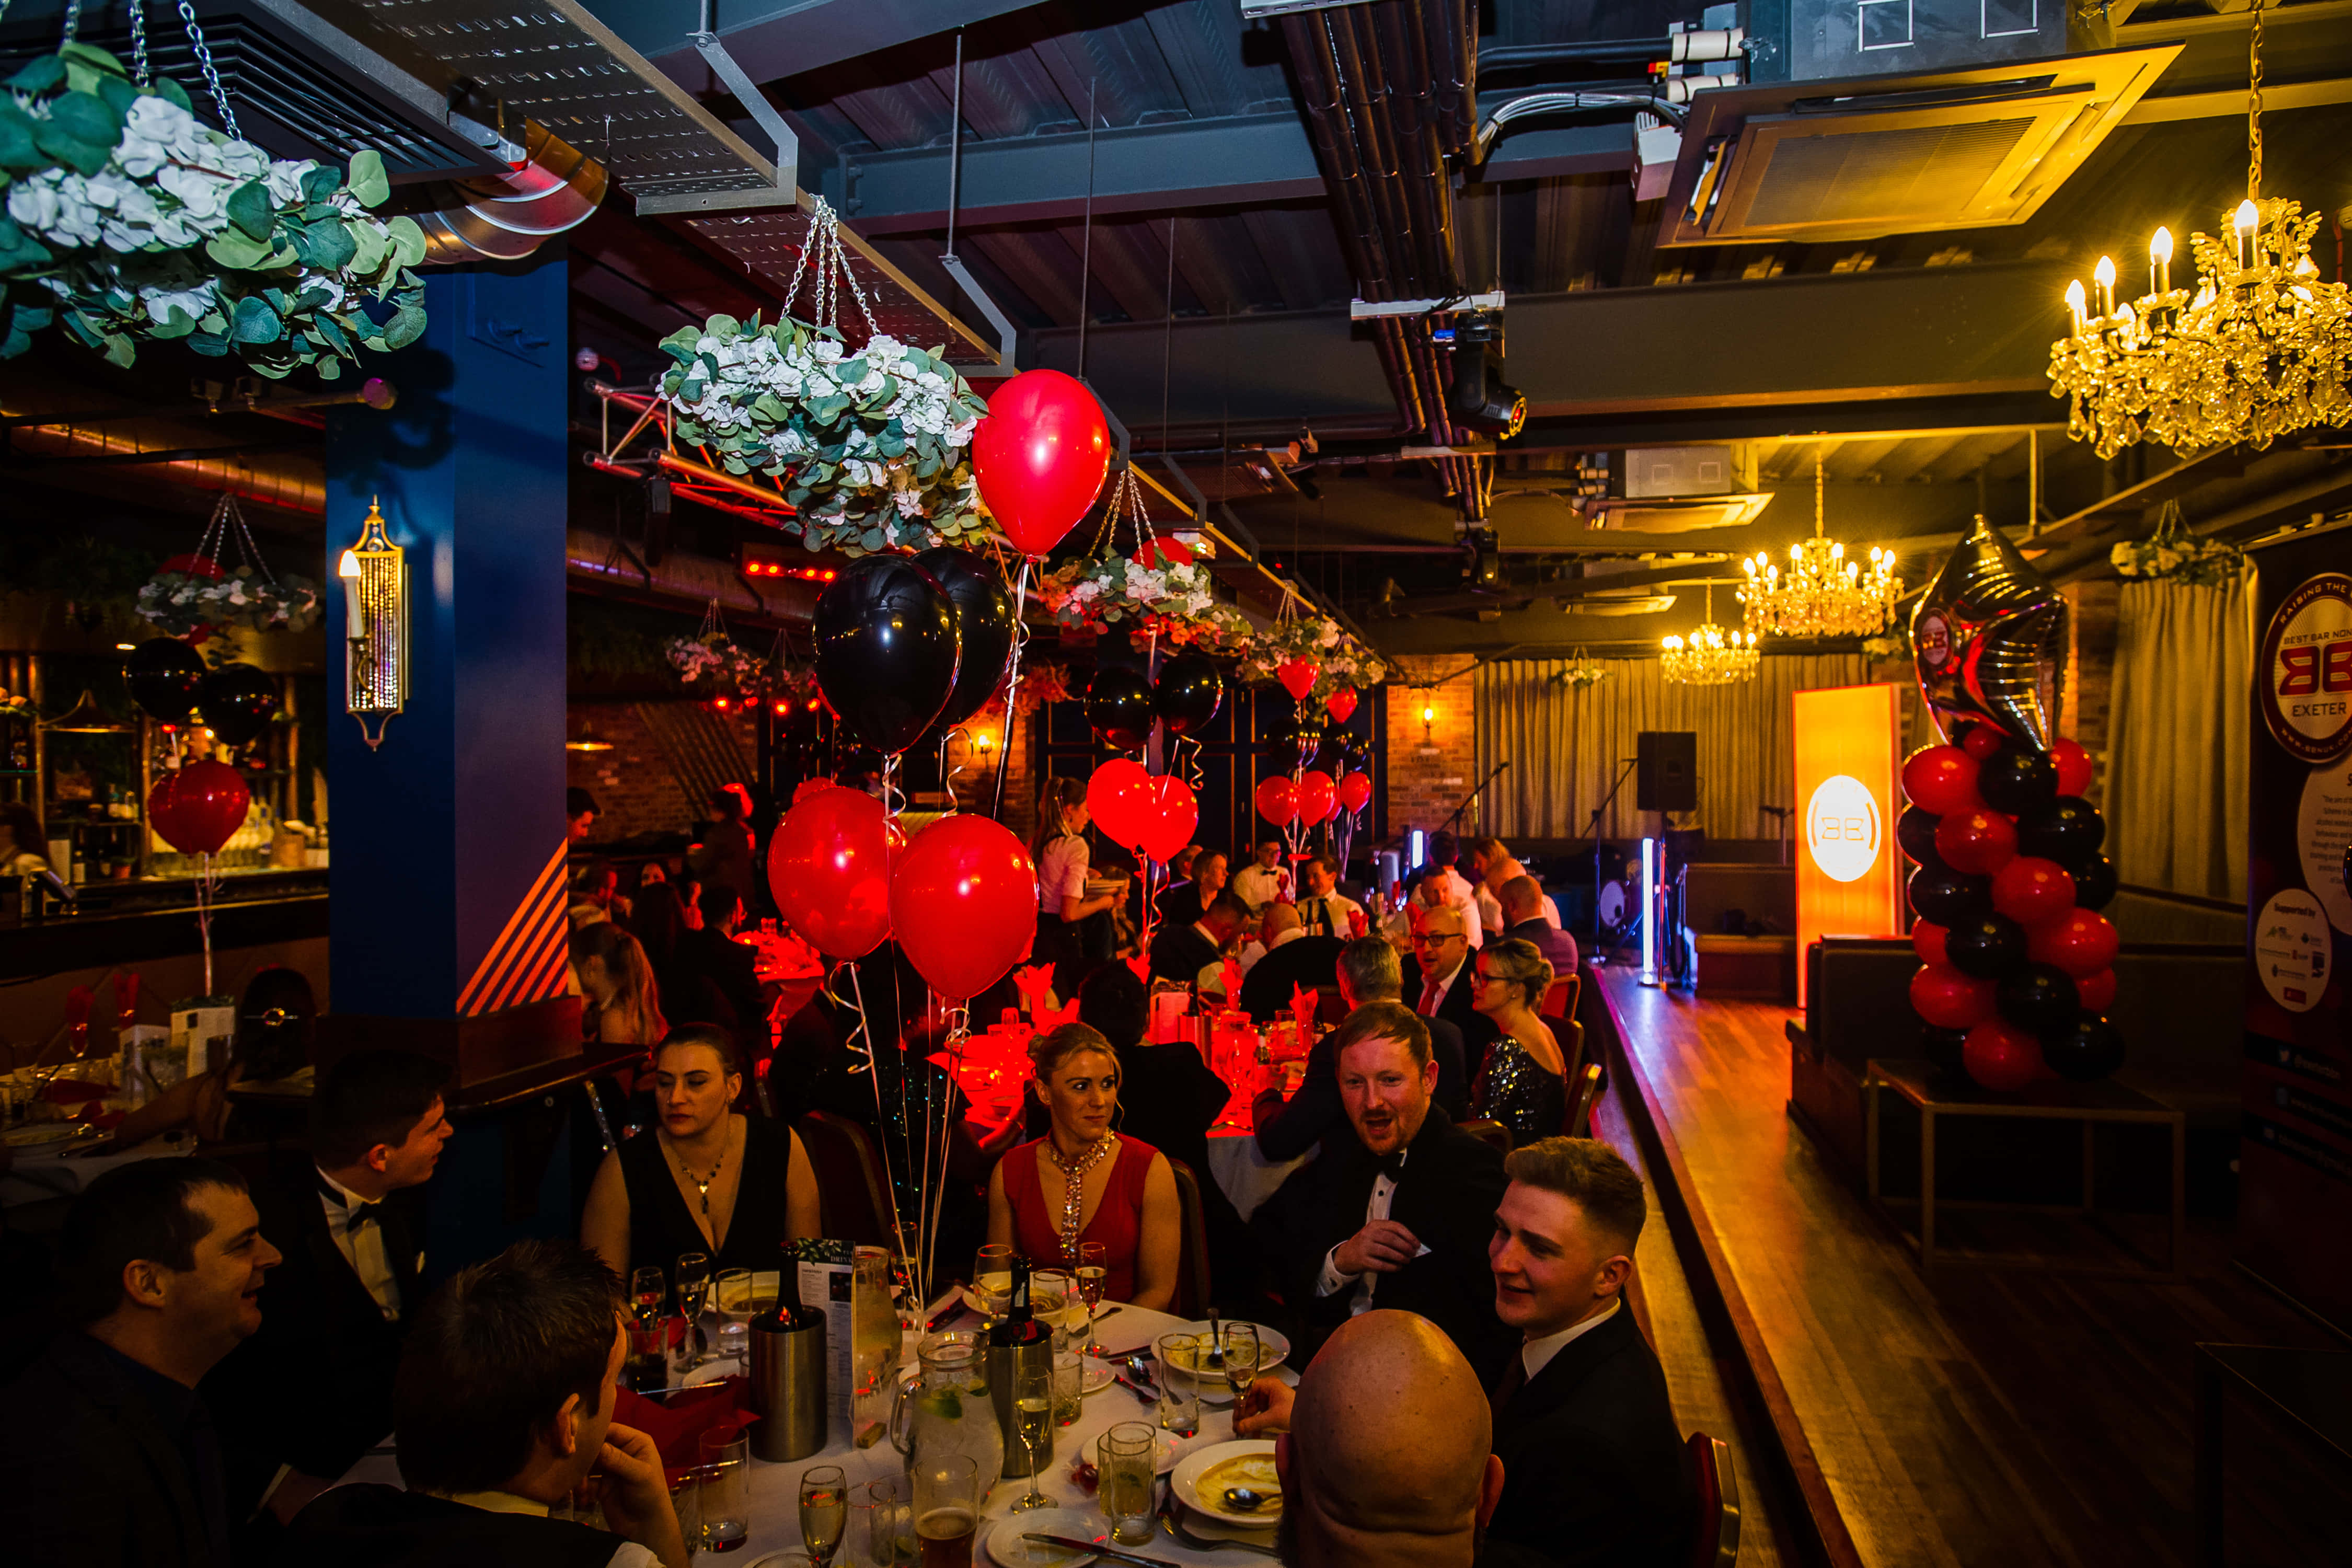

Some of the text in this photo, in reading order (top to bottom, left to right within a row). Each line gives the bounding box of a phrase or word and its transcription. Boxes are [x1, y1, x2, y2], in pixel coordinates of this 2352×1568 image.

[2280, 582, 2347, 624] RAISING THE
[2284, 634, 2308, 644] BEST
[2311, 631, 2330, 641] BAR
[2292, 702, 2347, 717] EXETER
